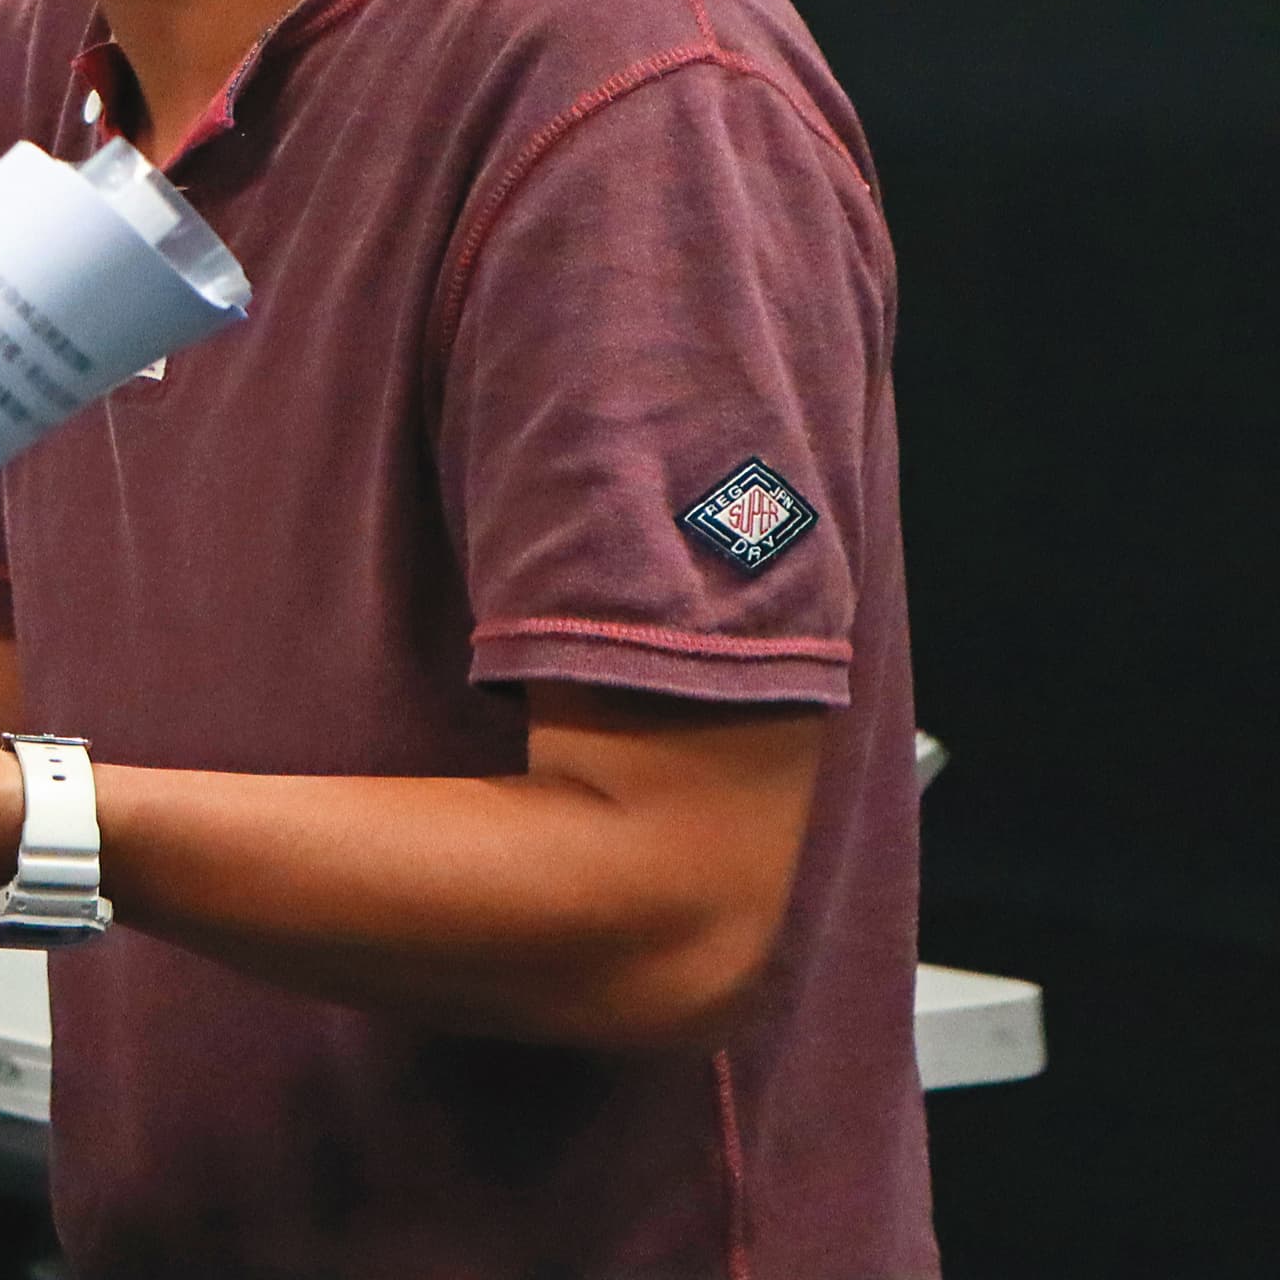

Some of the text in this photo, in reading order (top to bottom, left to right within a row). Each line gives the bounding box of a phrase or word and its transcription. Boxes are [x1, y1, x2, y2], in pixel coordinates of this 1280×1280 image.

[704, 484, 744, 517] REG
[728, 487, 780, 538] SUPER
[769, 486, 795, 510] JPN
[730, 535, 776, 561] DRY
